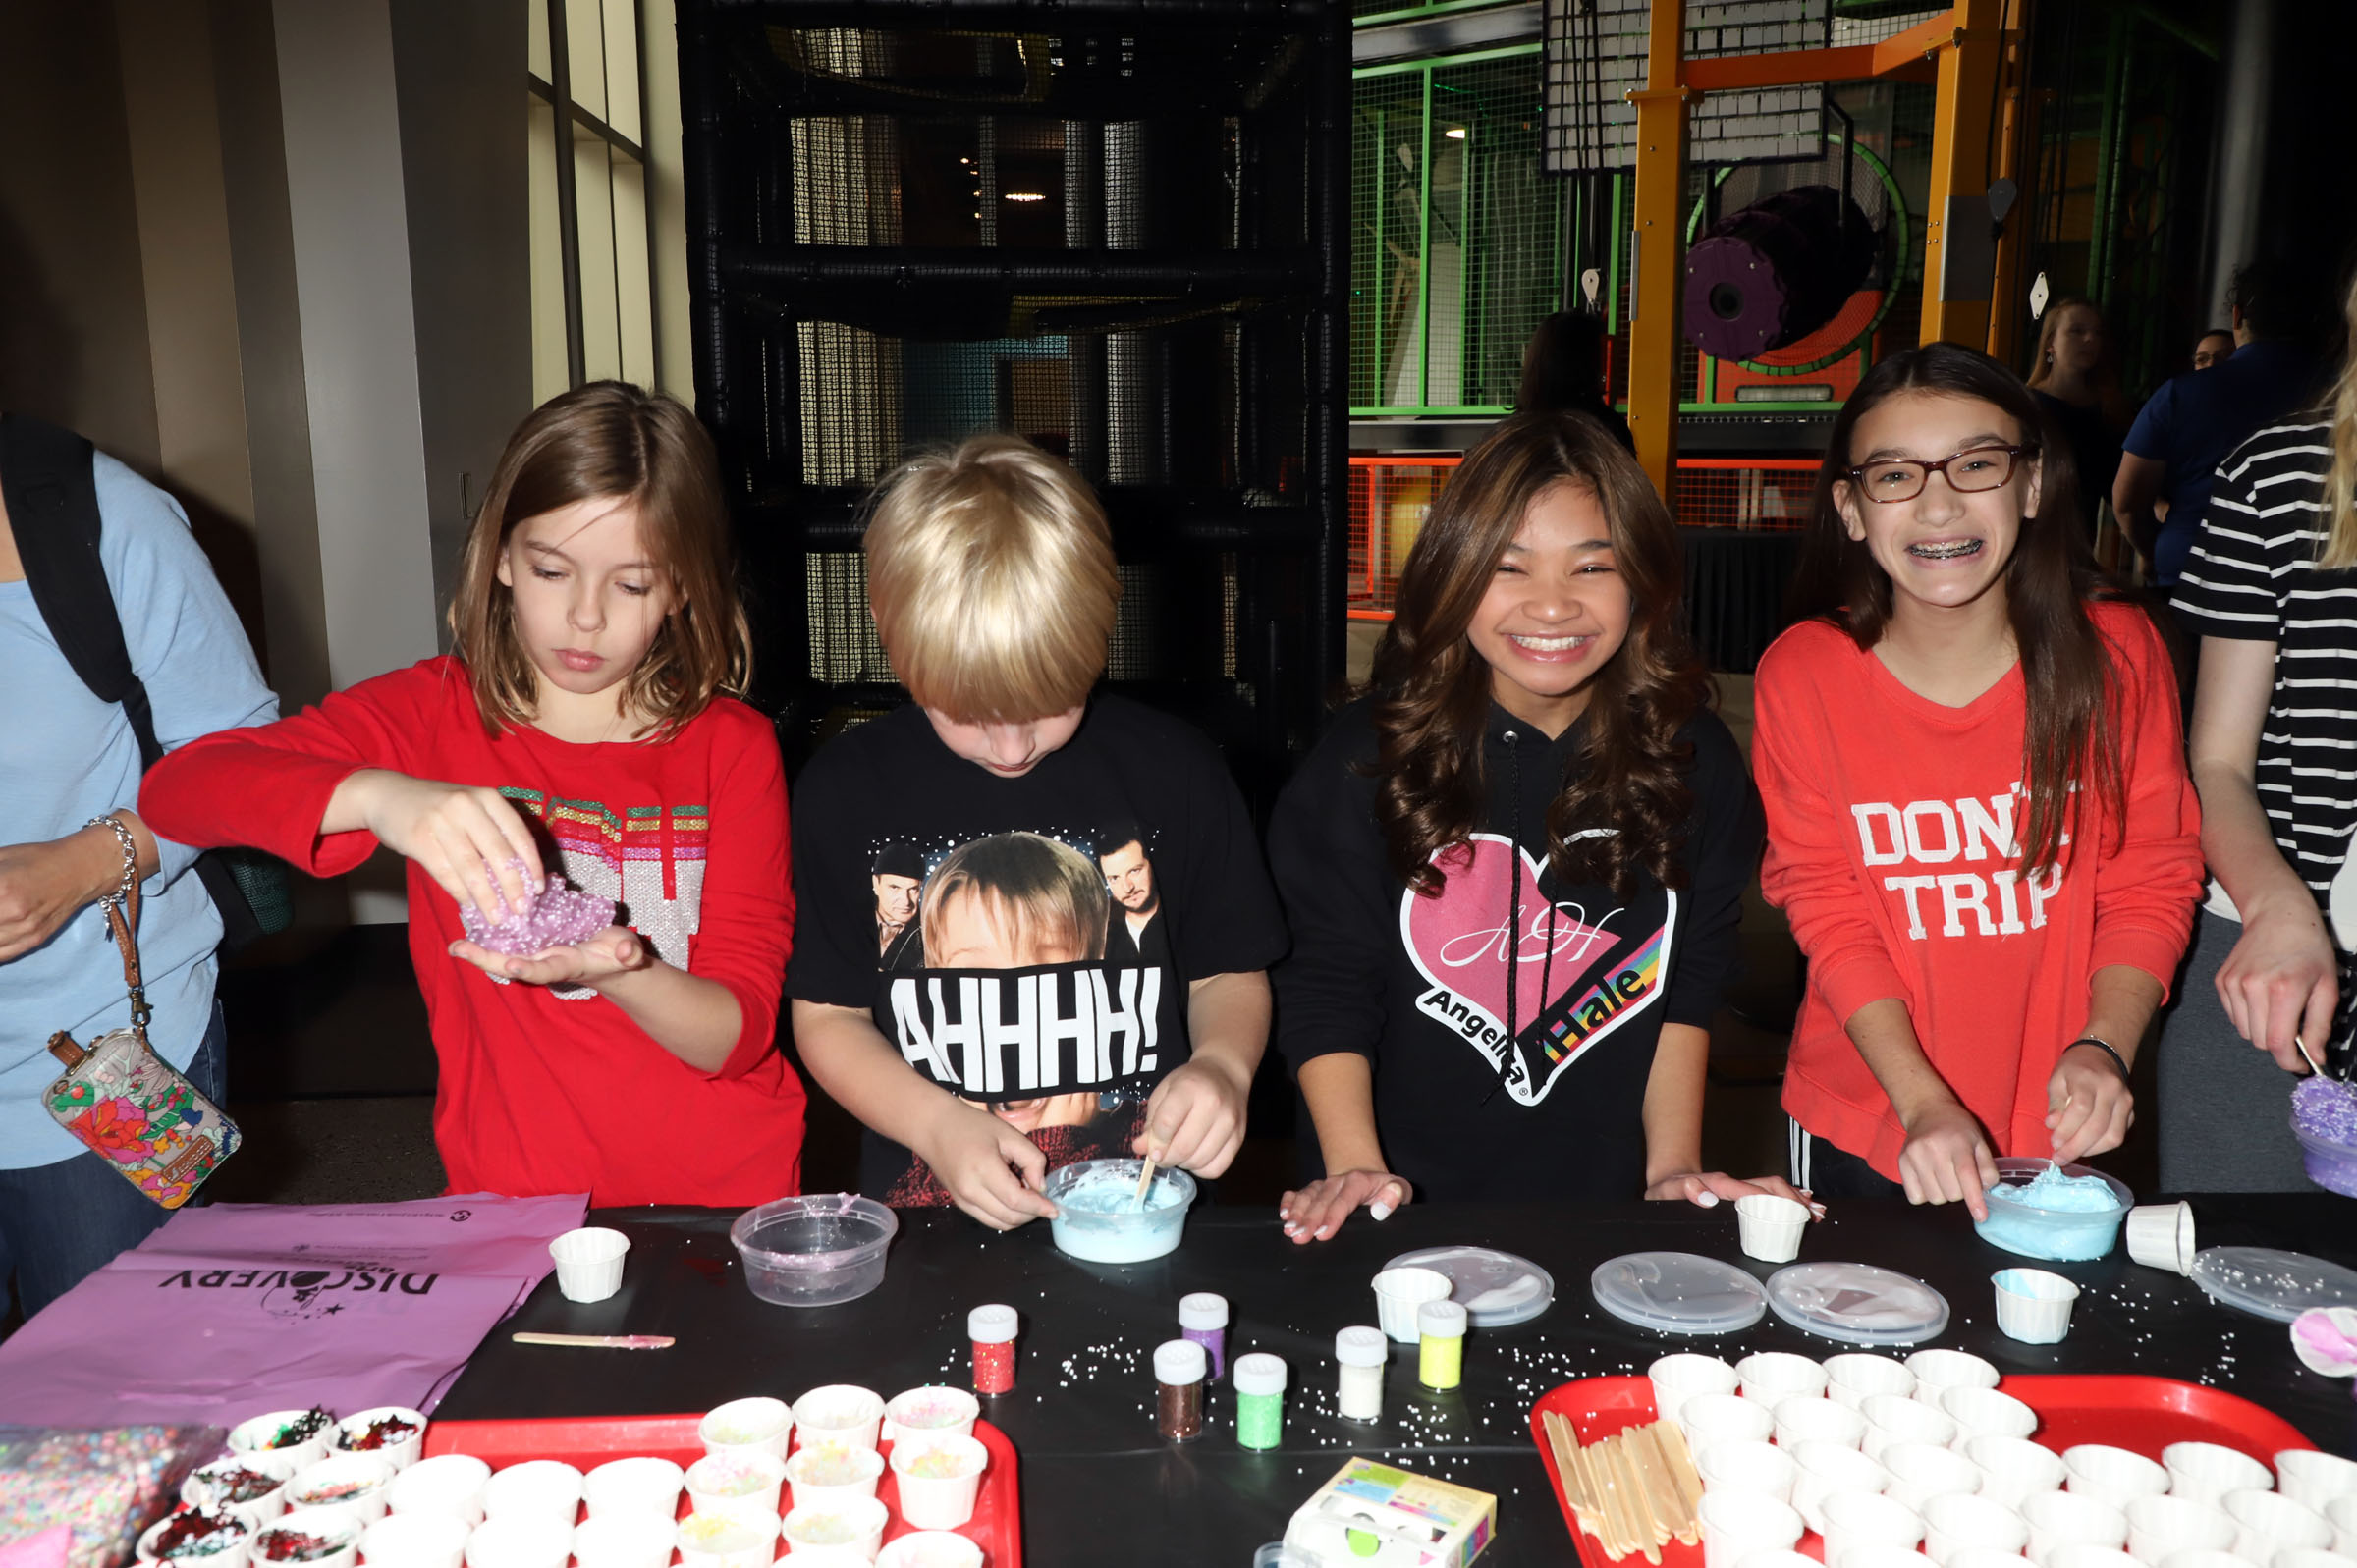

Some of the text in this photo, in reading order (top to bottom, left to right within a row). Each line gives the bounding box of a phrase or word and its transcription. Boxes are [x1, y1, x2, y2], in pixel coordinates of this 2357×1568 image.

[1885, 862, 2063, 940] TRIP
[891, 967, 1161, 1092] AHHHH!
[1541, 969, 1648, 1058] Hale
